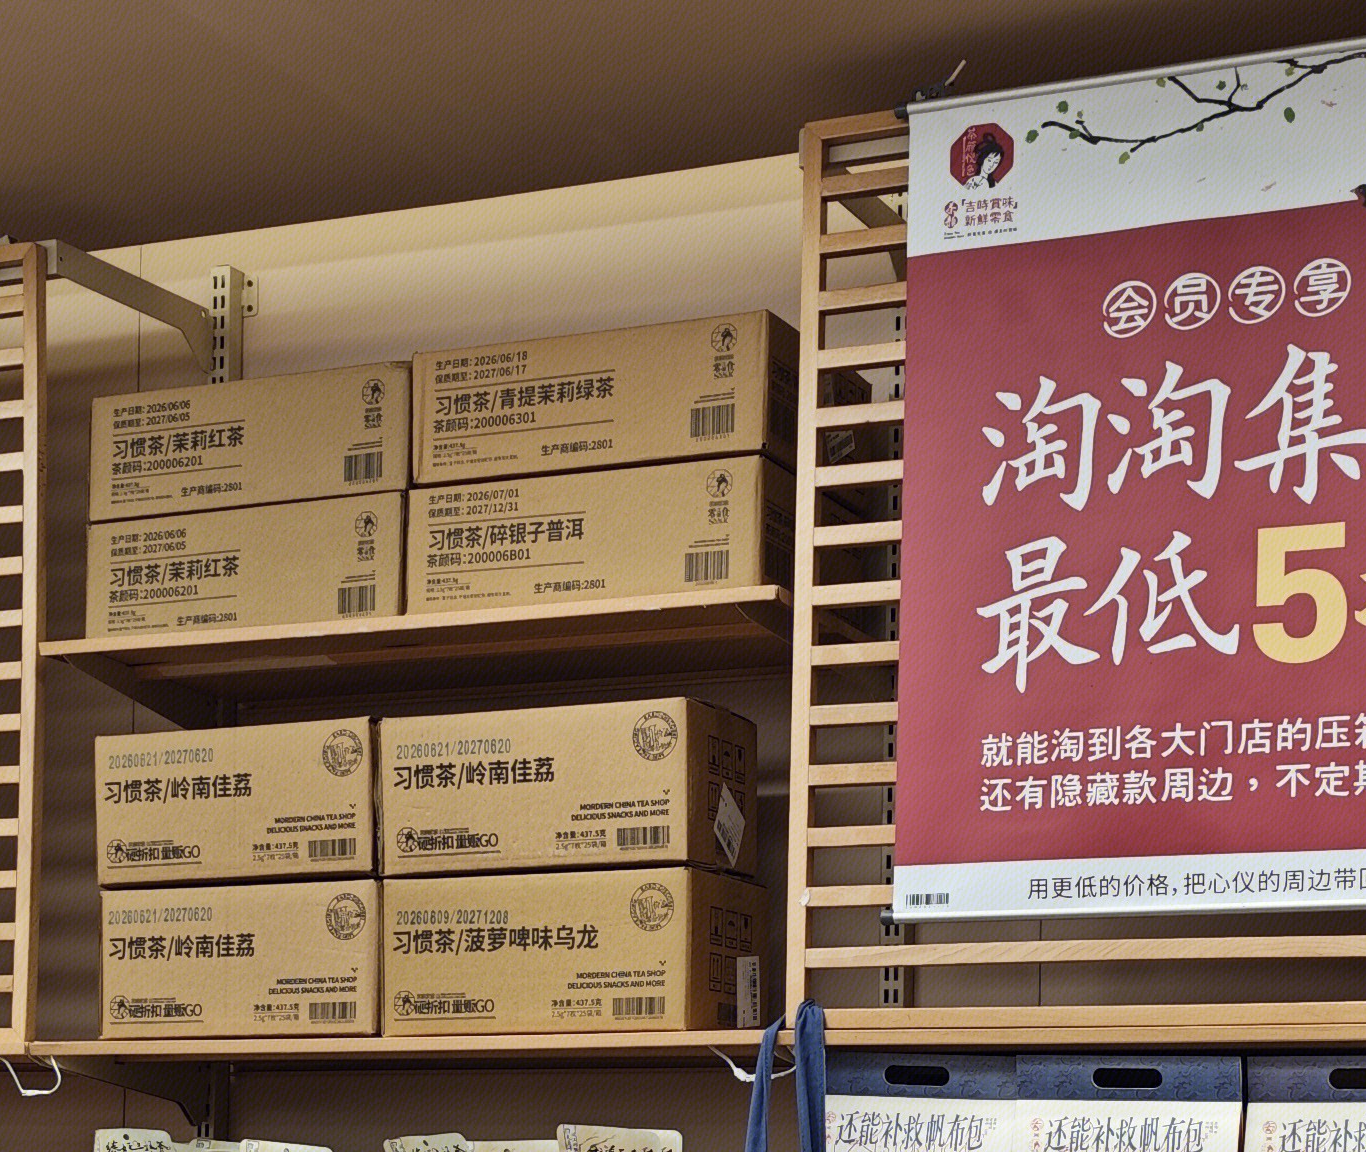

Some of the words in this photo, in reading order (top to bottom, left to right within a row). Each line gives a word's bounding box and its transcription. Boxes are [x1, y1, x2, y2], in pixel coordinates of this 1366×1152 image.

[1102, 257, 1352, 339] 会员专享
[434, 376, 614, 416] 习惯茶/青提茉莉绿茶
[112, 425, 245, 460] 习惯茶/茉莉红茶
[428, 517, 584, 551] 习惯茶/碎银子普洱
[109, 555, 239, 588] 习惯茶/茉莉红茶
[104, 772, 252, 805] 习惯茶/岭南佳荔
[393, 757, 555, 790] 习惯茶/岭南佳荔
[108, 932, 255, 962] 习惯茶/岭南佳荔
[392, 924, 599, 956] 习惯茶/菠萝啤味乌龙
